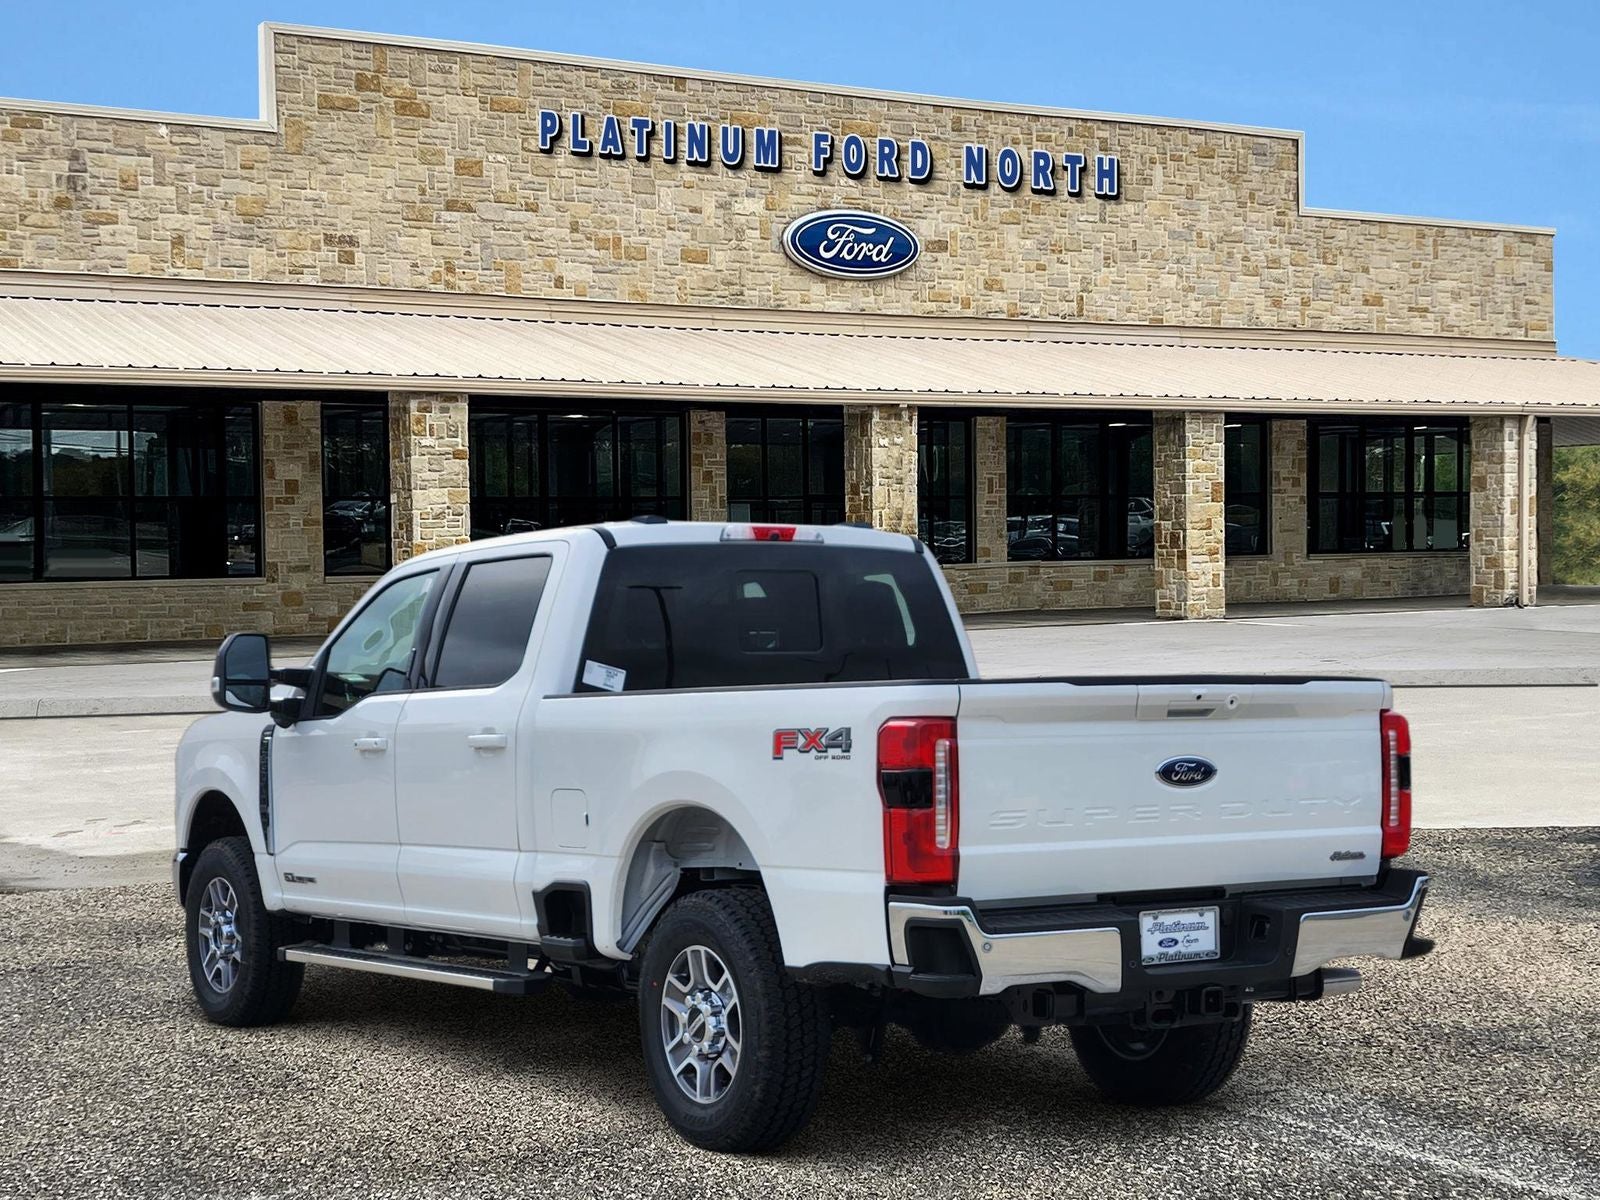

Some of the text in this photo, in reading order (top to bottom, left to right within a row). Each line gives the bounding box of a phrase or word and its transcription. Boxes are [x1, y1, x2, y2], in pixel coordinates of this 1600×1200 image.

[538, 109, 1120, 199] PLATINUM FORD NORTH
[818, 222, 895, 263] Ford
[772, 727, 852, 760] FX4
[1171, 762, 1205, 781] Ford
[988, 797, 1362, 830] SUPER DUTY
[1158, 951, 1203, 962] Platinum
